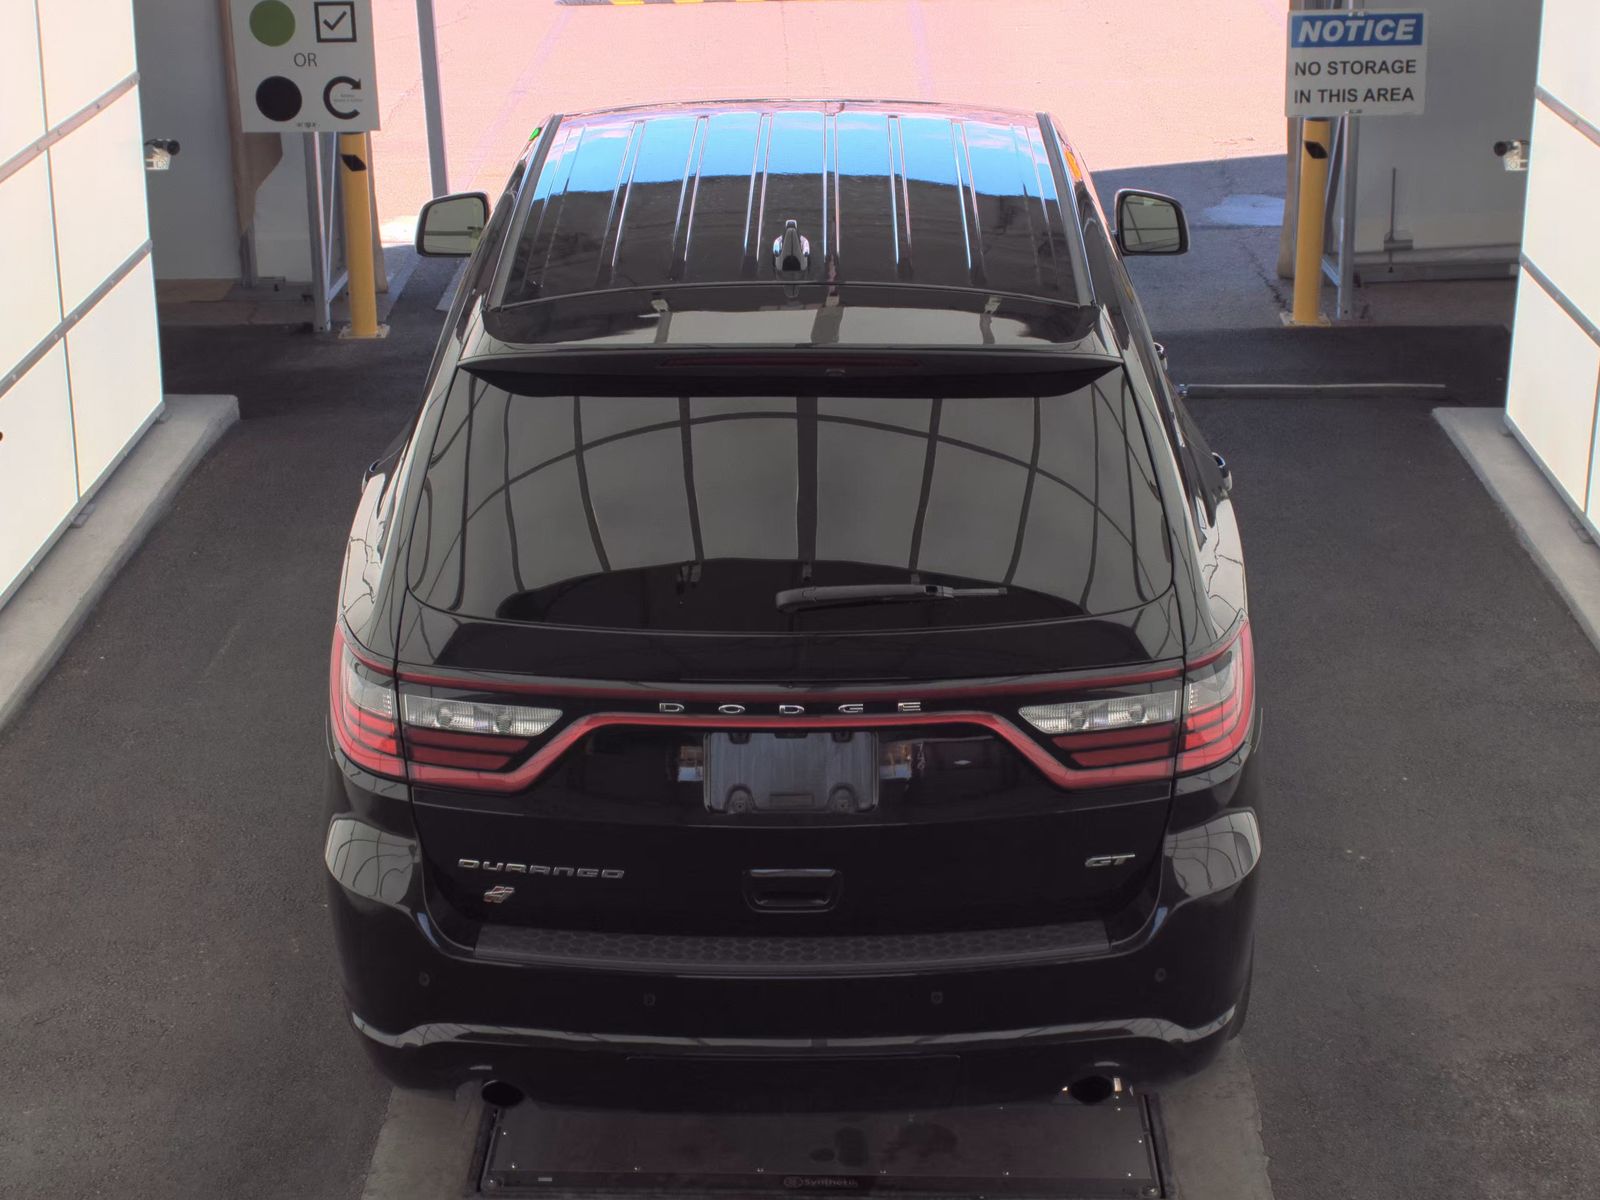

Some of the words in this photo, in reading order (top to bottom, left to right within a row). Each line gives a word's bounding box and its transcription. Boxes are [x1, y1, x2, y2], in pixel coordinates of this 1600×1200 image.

[1299, 19, 1416, 42] NOTICE
[294, 52, 317, 67] OR
[1295, 62, 1321, 76] NO
[1327, 60, 1417, 76] STORAGE
[1294, 89, 1311, 104] IN
[1317, 88, 1358, 103] THIS
[1363, 87, 1414, 103] AREA
[659, 701, 921, 714] DODGE
[457, 858, 625, 879] DURANGO
[1085, 854, 1136, 867] GT
